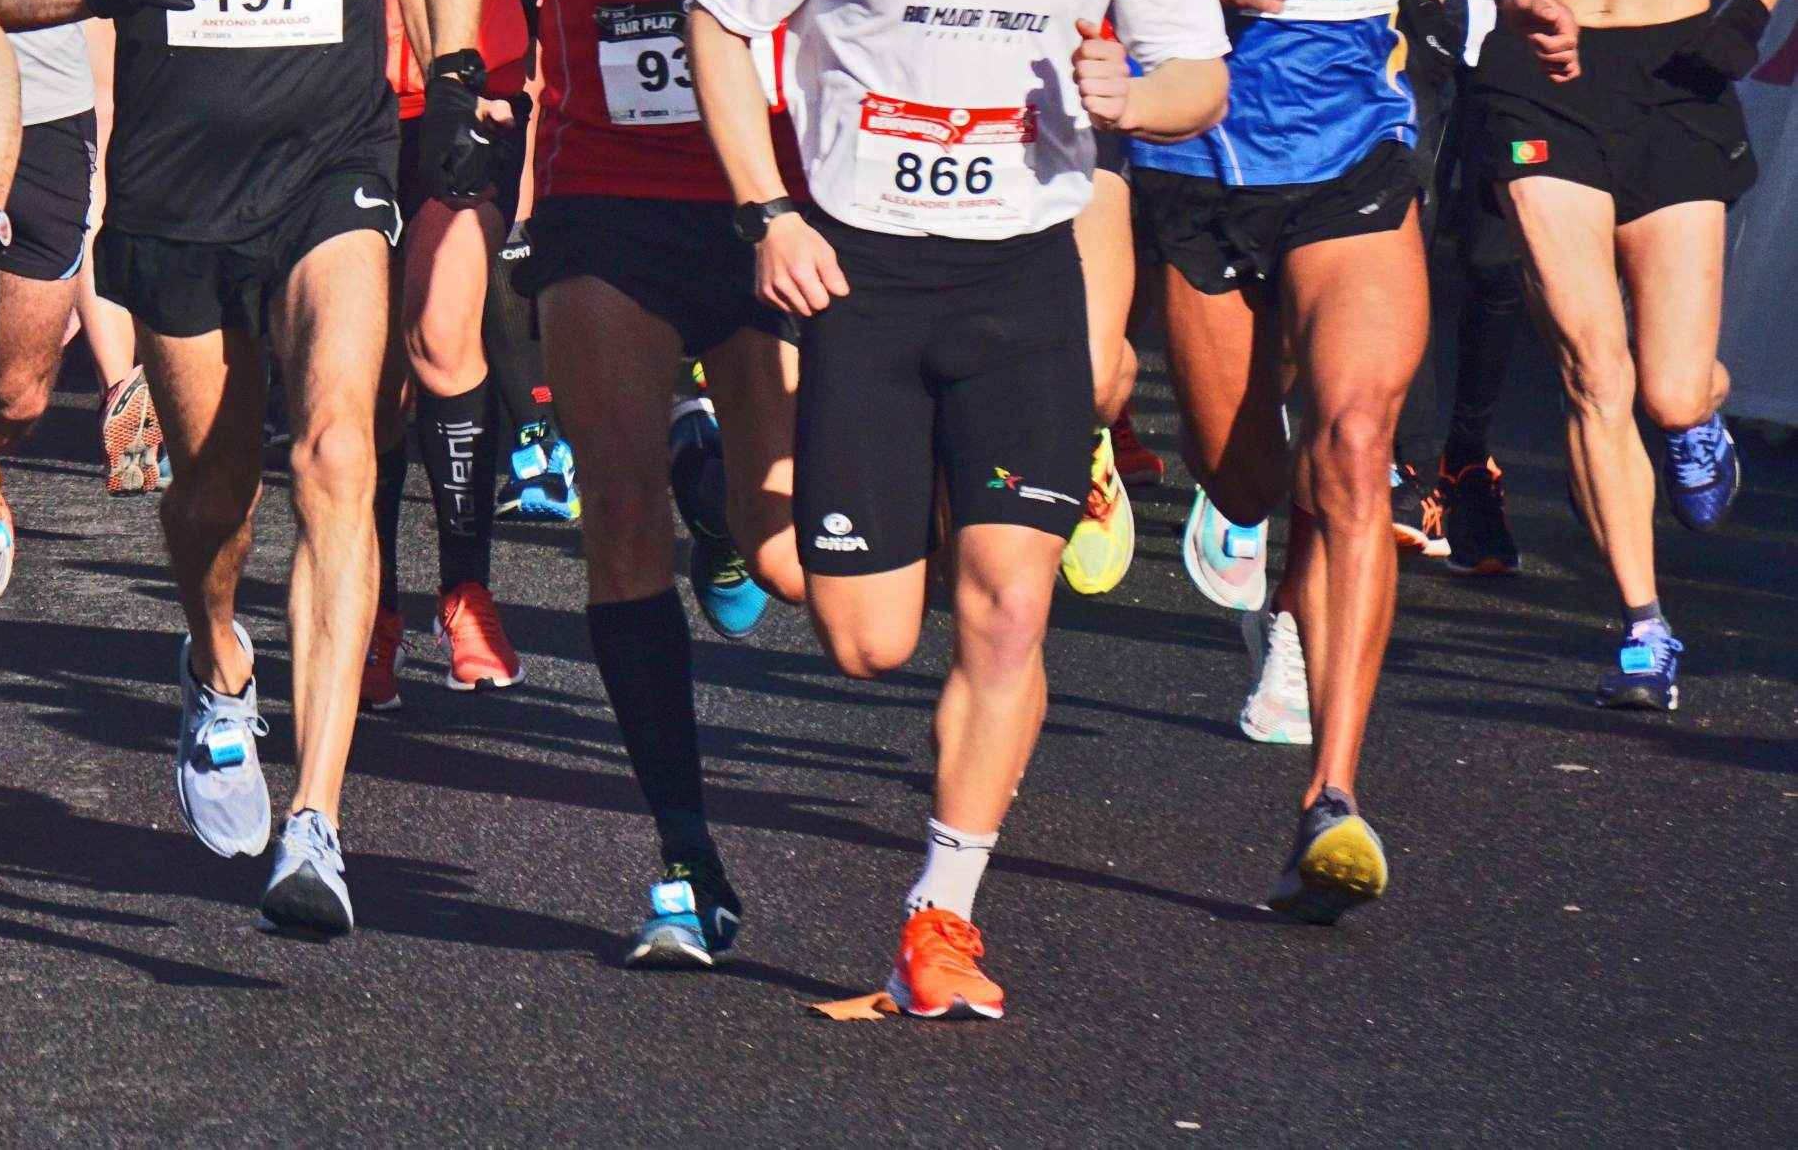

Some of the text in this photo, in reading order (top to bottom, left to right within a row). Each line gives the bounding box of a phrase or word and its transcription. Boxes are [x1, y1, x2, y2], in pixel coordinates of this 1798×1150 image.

[202, 15, 311, 27] ANTÓNIO ARAÚJO
[614, 16, 678, 36] FAIR PLAY
[894, 151, 993, 197] 866
[880, 193, 950, 210] ALEXANDRE
